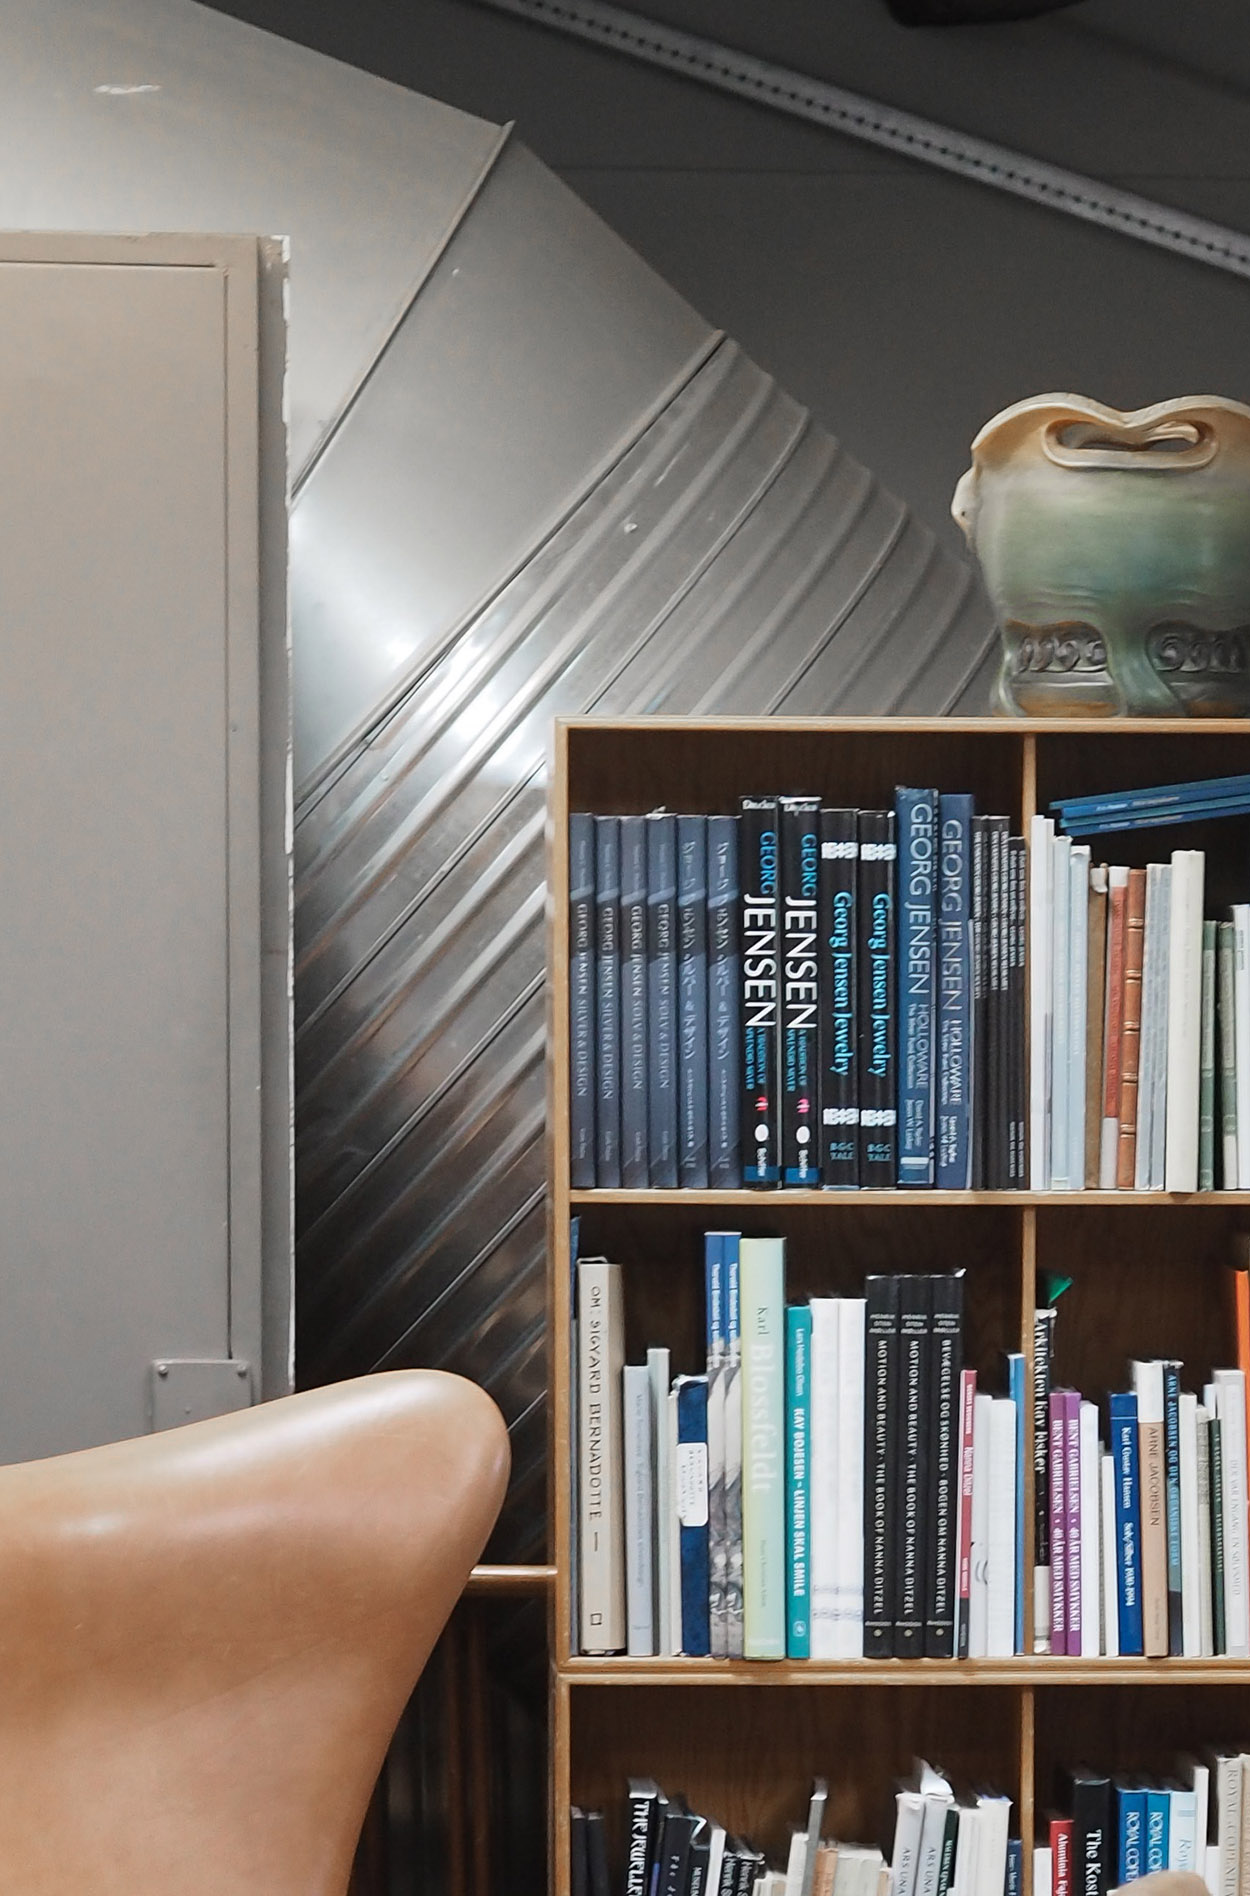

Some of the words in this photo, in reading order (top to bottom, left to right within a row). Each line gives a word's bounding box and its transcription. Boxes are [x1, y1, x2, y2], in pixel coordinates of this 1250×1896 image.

[759, 831, 777, 894] GEORG
[801, 833, 816, 897] GEORG
[908, 803, 932, 896] GEORG
[940, 819, 963, 912] GEORG
[829, 892, 852, 948] Georg
[867, 893, 890, 949] Georg
[743, 894, 777, 1027] JENSEN
[785, 896, 818, 1029] JENSEN
[905, 902, 930, 995] JENSEN
[937, 919, 962, 1011] JENSEN
[833, 952, 852, 1009] Jensen
[871, 954, 890, 1010] Jensen
[829, 1012, 853, 1076] Jewelry
[868, 1014, 891, 1077] Jewelry
[915, 1004, 930, 1090] HOLLOWARE
[949, 1020, 963, 1105] HOLLOWARE
[757, 1307, 770, 1336] Karl
[877, 1340, 888, 1385] MOTION
[940, 1339, 952, 1400] BEVÆGELSE
[1034, 1321, 1048, 1398] Arkitekten
[751, 1342, 774, 1493] Blossfeldt
[793, 1407, 807, 1429] KAY
[876, 1387, 887, 1411] AND
[940, 1401, 950, 1418] OG
[1034, 1401, 1049, 1427] Kay
[875, 1413, 886, 1455] BEAUTY
[938, 1420, 950, 1472] SKØNHED
[1034, 1431, 1048, 1474] Fisker
[1052, 1419, 1064, 1448] BENT
[1147, 1427, 1159, 1460] ARNE
[793, 1431, 807, 1480] BOJESEN
[875, 1462, 886, 1485] THE
[964, 1446, 975, 1472] Nanna
[874, 1486, 886, 1518] BOOK
[937, 1479, 949, 1517] BOGEN
[963, 1473, 974, 1496] Ditzel
[1052, 1448, 1064, 1514] GABRIELSEN
[1148, 1462, 1161, 1527] JACOBSEN
[792, 1489, 807, 1529] LINJEN
[874, 1520, 885, 1534] OF
[937, 1518, 948, 1536] OM
[793, 1531, 807, 1561] SKAL
[1052, 1527, 1064, 1538] 40
[1052, 1538, 1065, 1555] ÅR
[873, 1536, 885, 1576] NANNA
[936, 1537, 947, 1576] NANNA
[1052, 1555, 1064, 1579] MED
[793, 1562, 806, 1597] SMILE
[873, 1577, 884, 1614] DITZEL
[935, 1577, 946, 1614] DITZEL
[1052, 1579, 1064, 1632] SMYKKER
[1225, 1769, 1238, 1818] ROYAL
[632, 1800, 650, 1832] THE
[1057, 1833, 1068, 1878] Aluminia
[1085, 1829, 1102, 1859] The
